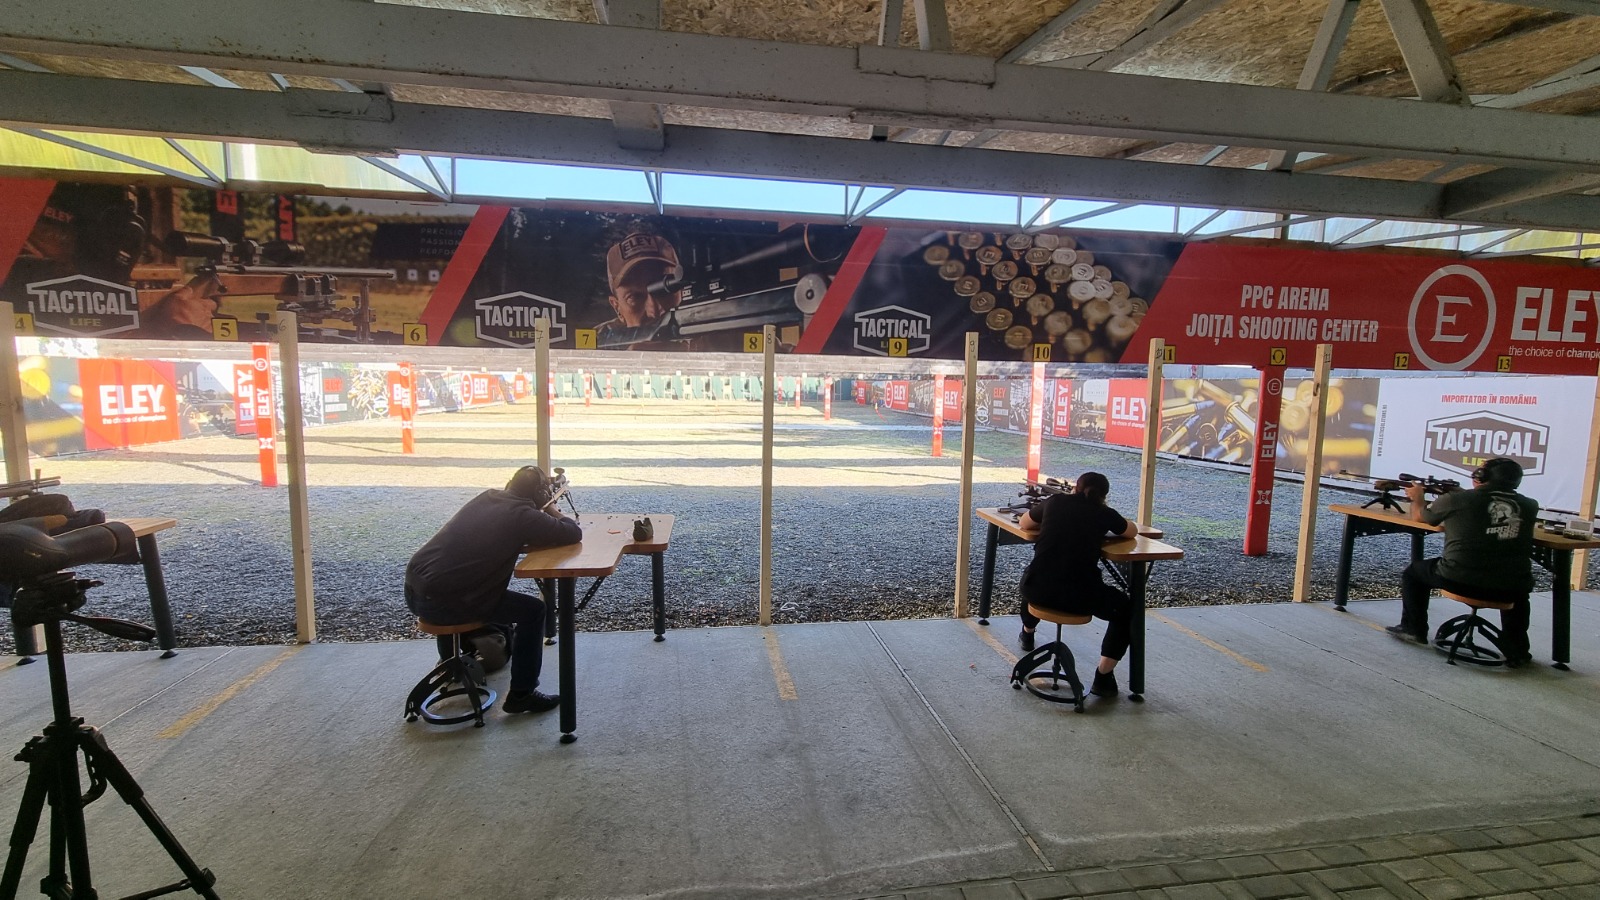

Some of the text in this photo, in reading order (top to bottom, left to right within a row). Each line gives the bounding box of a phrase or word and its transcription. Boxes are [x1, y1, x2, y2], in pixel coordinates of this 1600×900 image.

[623, 236, 652, 252] ELEY
[36, 289, 134, 316] TACTICAL
[1240, 284, 1330, 312] PPC ARENA
[14, 316, 26, 331] 4
[69, 317, 104, 328] LIFE
[483, 304, 560, 329] TACTICAL
[1429, 294, 1473, 343] E
[220, 322, 232, 338] 5
[278, 318, 287, 332] 6
[861, 317, 924, 340] TACTICAL
[1185, 313, 1379, 346] JOIȚA SHOOTING CENTER
[409, 327, 421, 342] 6
[509, 330, 535, 339] LIFE
[581, 333, 590, 345] 7
[748, 336, 758, 350] 8
[894, 341, 903, 355] 9
[1508, 345, 1523, 356] the
[1524, 346, 1554, 357] choice
[1555, 346, 1566, 357] of
[1034, 345, 1050, 360] 10
[1163, 347, 1173, 361] 11
[1395, 355, 1408, 368] 12
[1498, 358, 1511, 370] 13
[99, 384, 164, 416] ELEY
[237, 369, 255, 421] ELEY
[894, 385, 906, 401] ELEY
[944, 390, 958, 406] ELEY
[1441, 394, 1487, 404] IMPORTATOR
[1499, 393, 1538, 405] ROMÂNIA
[256, 388, 270, 416] ELEY
[1056, 384, 1069, 427] ELEY
[1261, 421, 1277, 459] ELEY
[1433, 427, 1534, 458] TACTICAL
[1462, 456, 1486, 467] LIF
